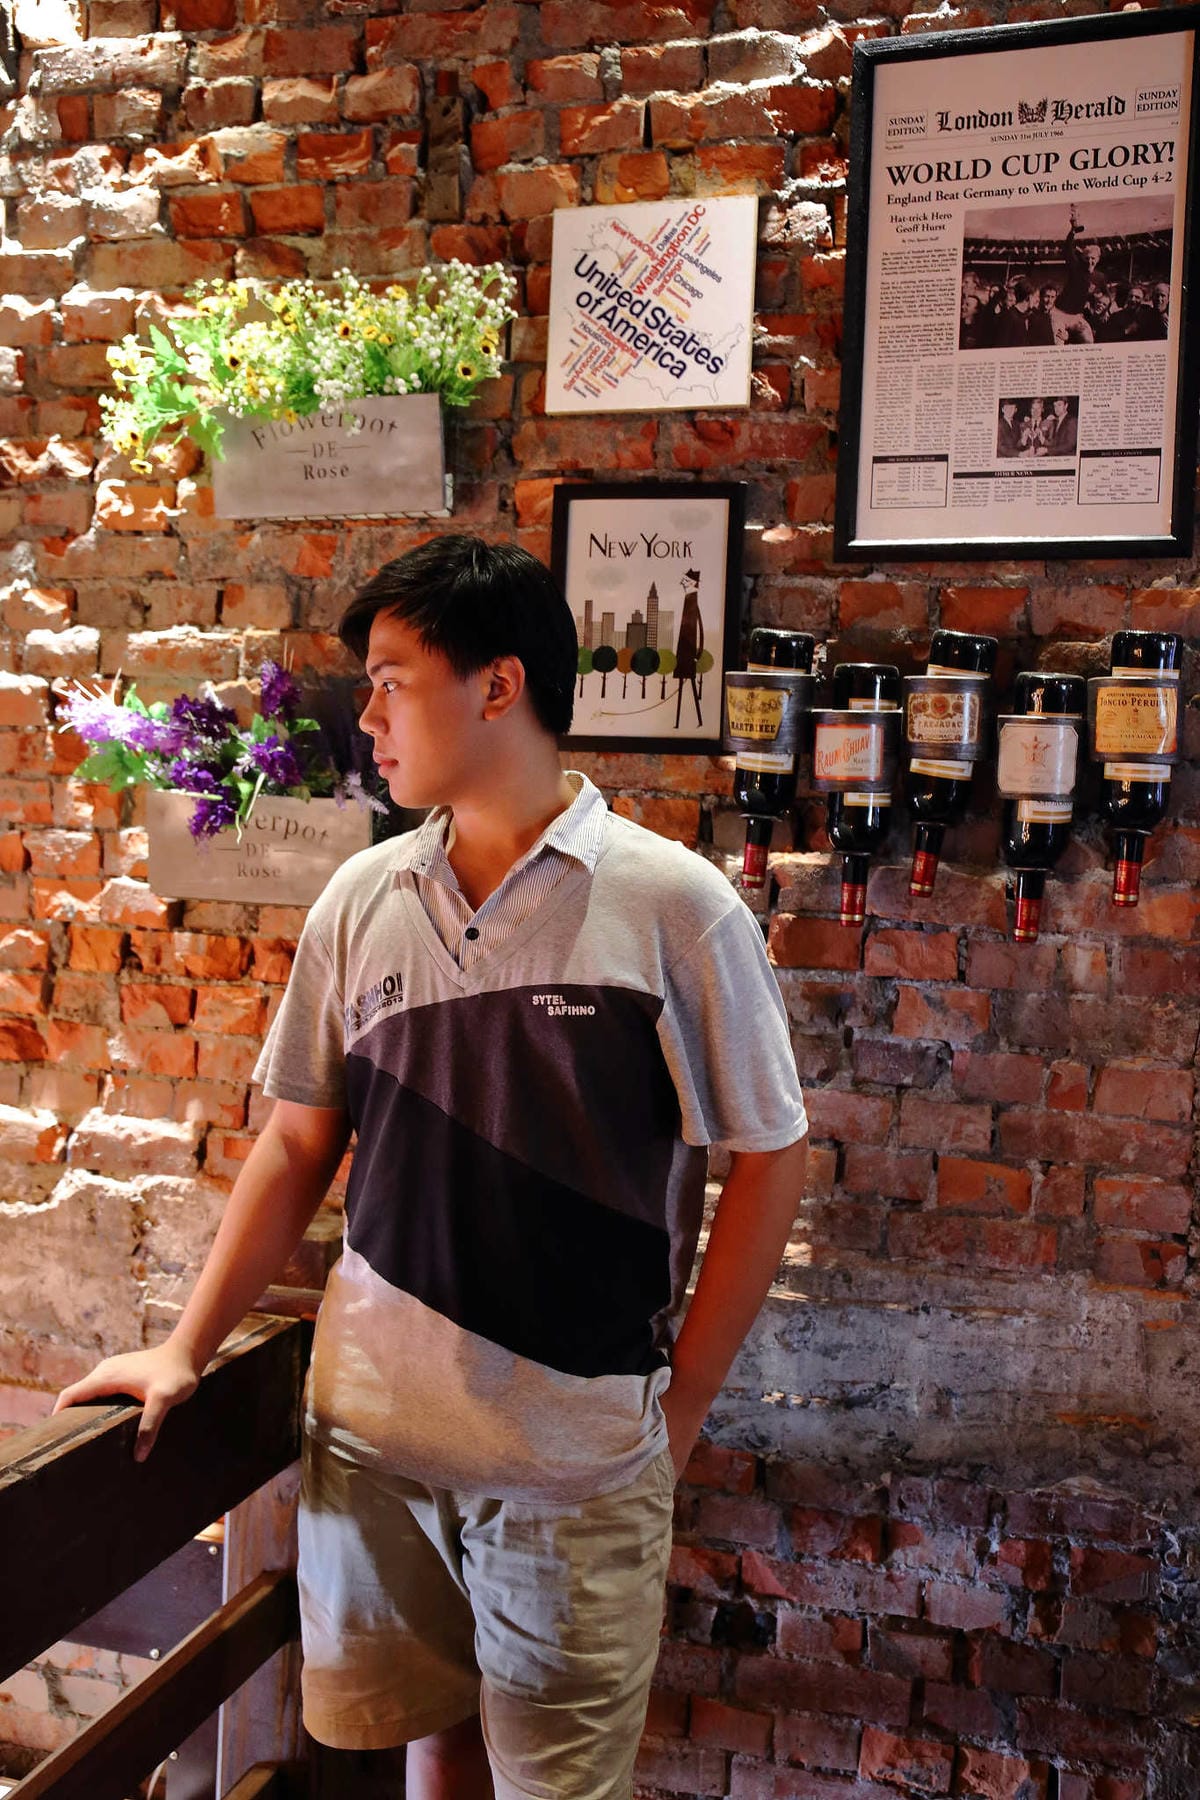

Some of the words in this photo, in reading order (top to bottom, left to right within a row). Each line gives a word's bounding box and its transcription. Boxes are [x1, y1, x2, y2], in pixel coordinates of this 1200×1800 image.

[1138, 89, 1178, 101] SUNDAY
[935, 109, 1013, 133] London
[1051, 95, 1126, 125] Herald
[1137, 100, 1178, 112] EDITION
[889, 115, 925, 126] SUNDAY
[887, 126, 926, 137] EDITION
[886, 158, 991, 186] WORLD
[1002, 152, 1060, 177] CUP
[1069, 141, 1175, 171] GLORY!
[887, 192, 931, 207] England
[936, 190, 959, 201] Beat
[963, 187, 1015, 199] Germany
[1018, 185, 1029, 195] to
[1033, 181, 1057, 193] Win
[1061, 180, 1080, 191] the
[1082, 175, 1119, 189] World
[1122, 174, 1148, 188] Cup
[1151, 171, 1173, 183] 4-2
[890, 212, 928, 223] Hat-trick
[931, 212, 952, 221] Hero
[896, 223, 918, 233] Geoff
[921, 223, 946, 232] Hurst
[656, 227, 677, 251] Dallas
[633, 225, 692, 295] Washington
[687, 204, 706, 226] DC
[672, 274, 703, 299] Chicago
[574, 253, 651, 319] United
[645, 307, 723, 374] States
[576, 291, 606, 314] of
[597, 305, 687, 379] America
[579, 321, 611, 348] Houston
[311, 441, 338, 458] DE
[303, 464, 349, 480] Rose
[238, 862, 281, 878] Rose
[532, 995, 566, 1006] SYTEL
[547, 1005, 596, 1017] SAFIHNO
